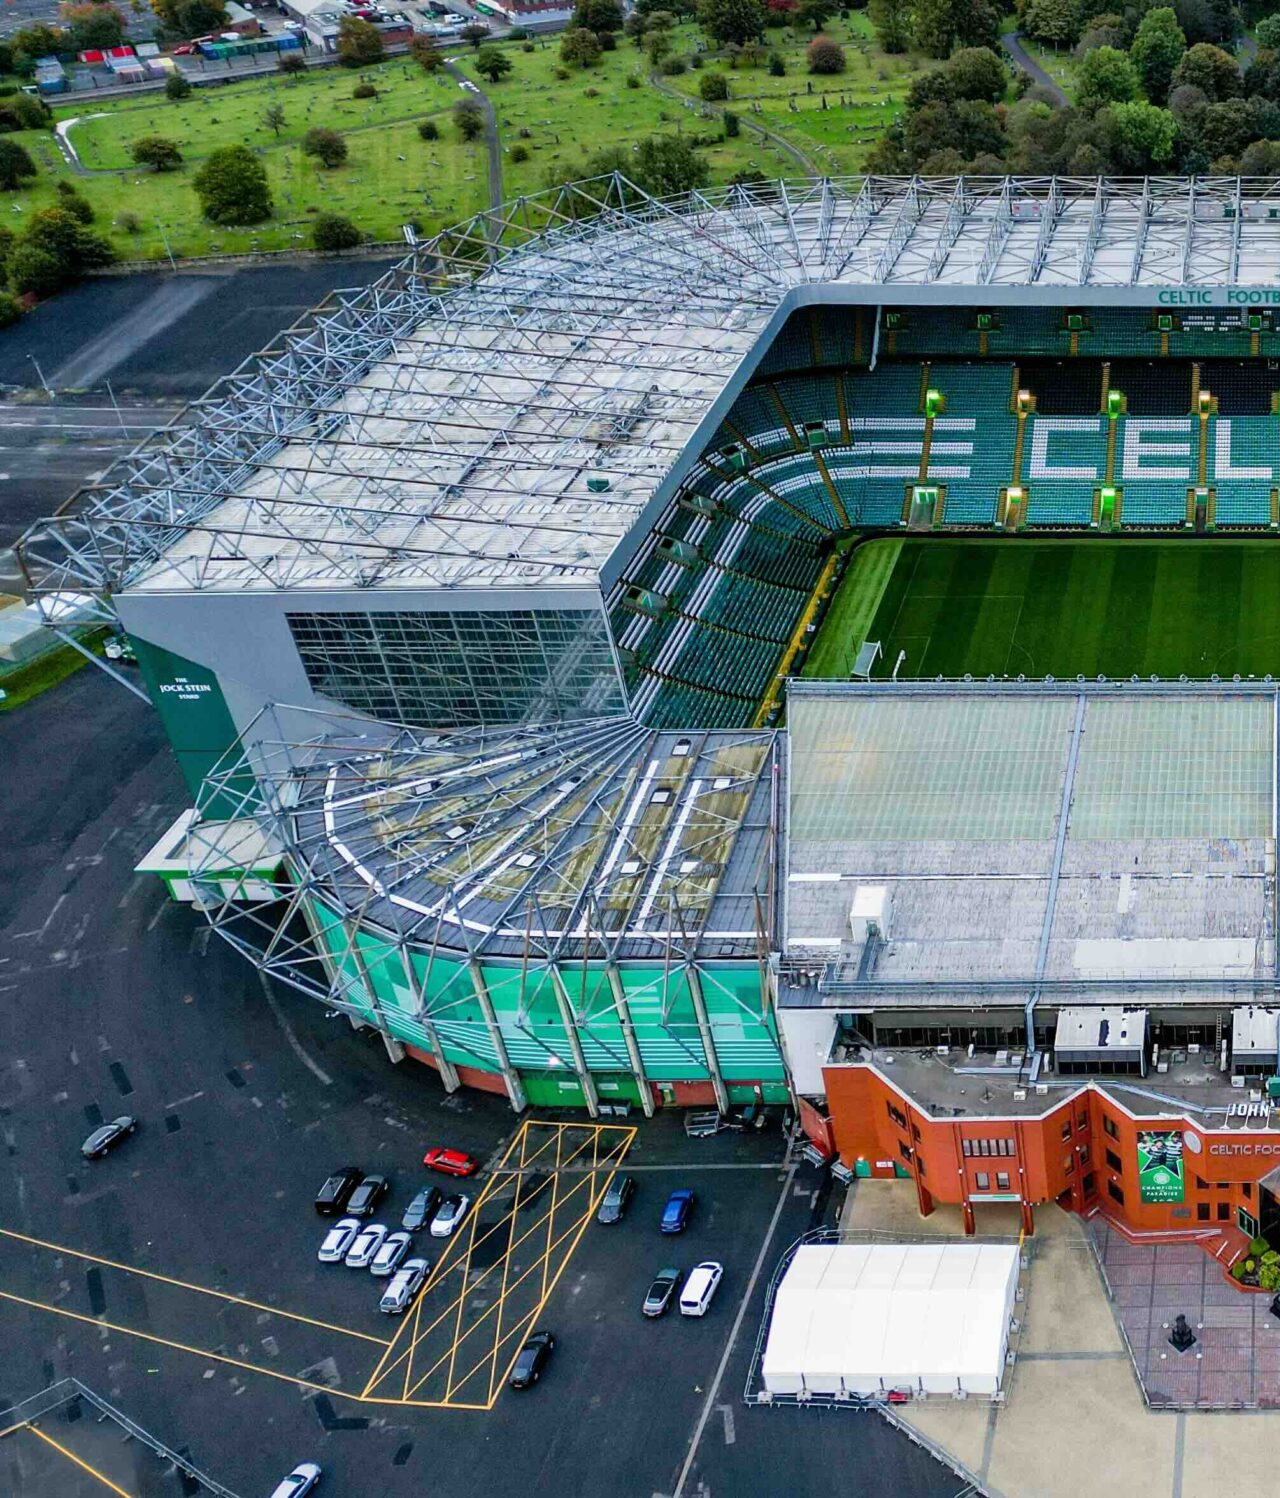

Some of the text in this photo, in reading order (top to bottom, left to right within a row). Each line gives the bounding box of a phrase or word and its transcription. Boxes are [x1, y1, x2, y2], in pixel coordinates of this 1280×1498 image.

[1158, 290, 1212, 304] CELTIC
[160, 685, 184, 693] JOCK
[1229, 1103, 1270, 1117] JOHN
[1209, 1144, 1252, 1155] CELTIC
